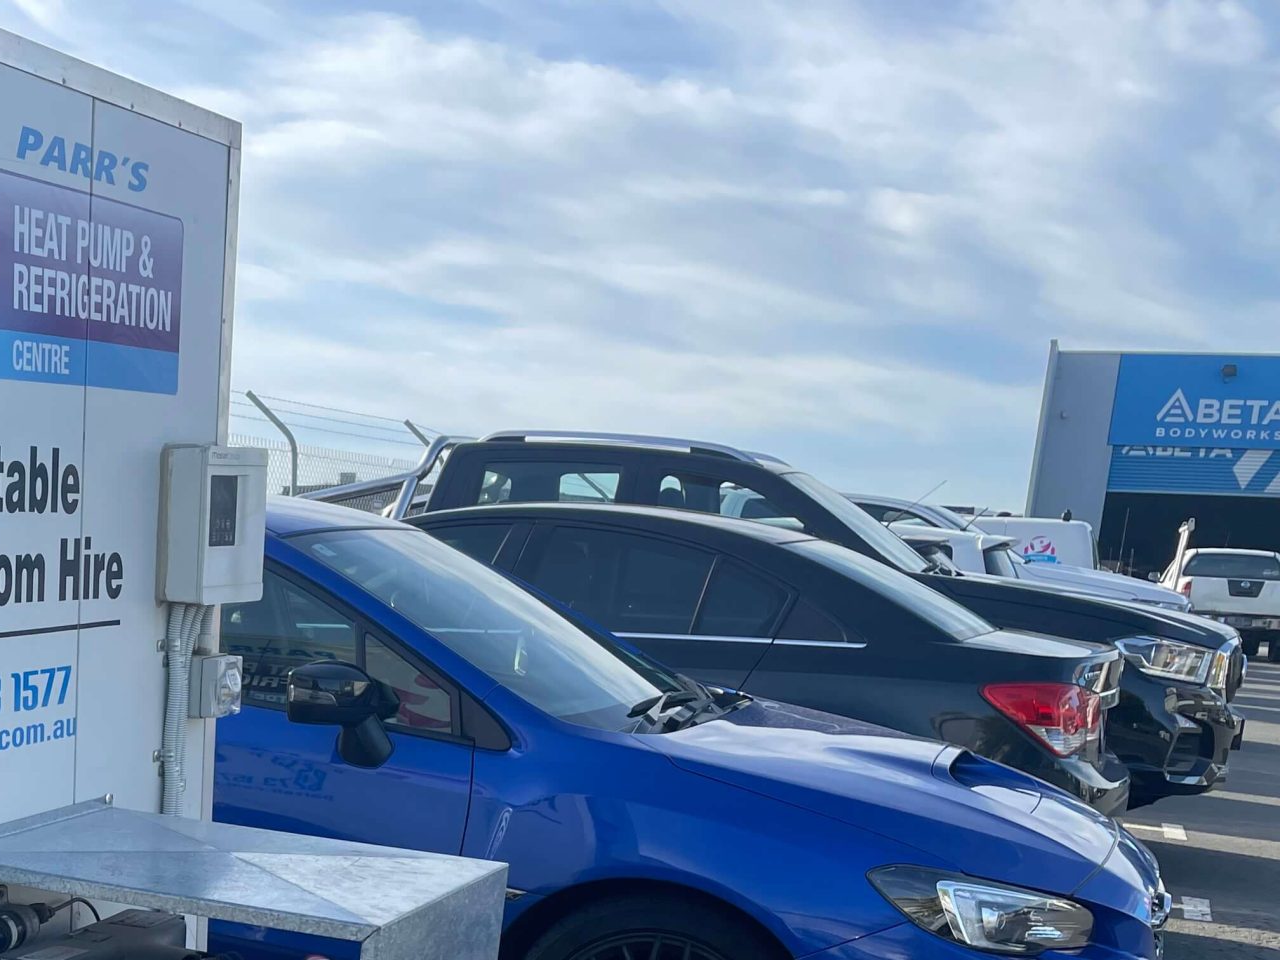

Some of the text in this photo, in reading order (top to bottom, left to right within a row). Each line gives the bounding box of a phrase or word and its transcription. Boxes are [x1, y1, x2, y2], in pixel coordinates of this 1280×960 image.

[16, 126, 149, 192] PARR'S
[14, 205, 153, 278] HEAT PUMP &
[14, 263, 172, 331] REFRIGERATION
[12, 339, 70, 375] CENTRE
[1155, 427, 1280, 440] BODYWORKS
[59, 536, 123, 601] Hire
[11, 665, 72, 711] 1577
